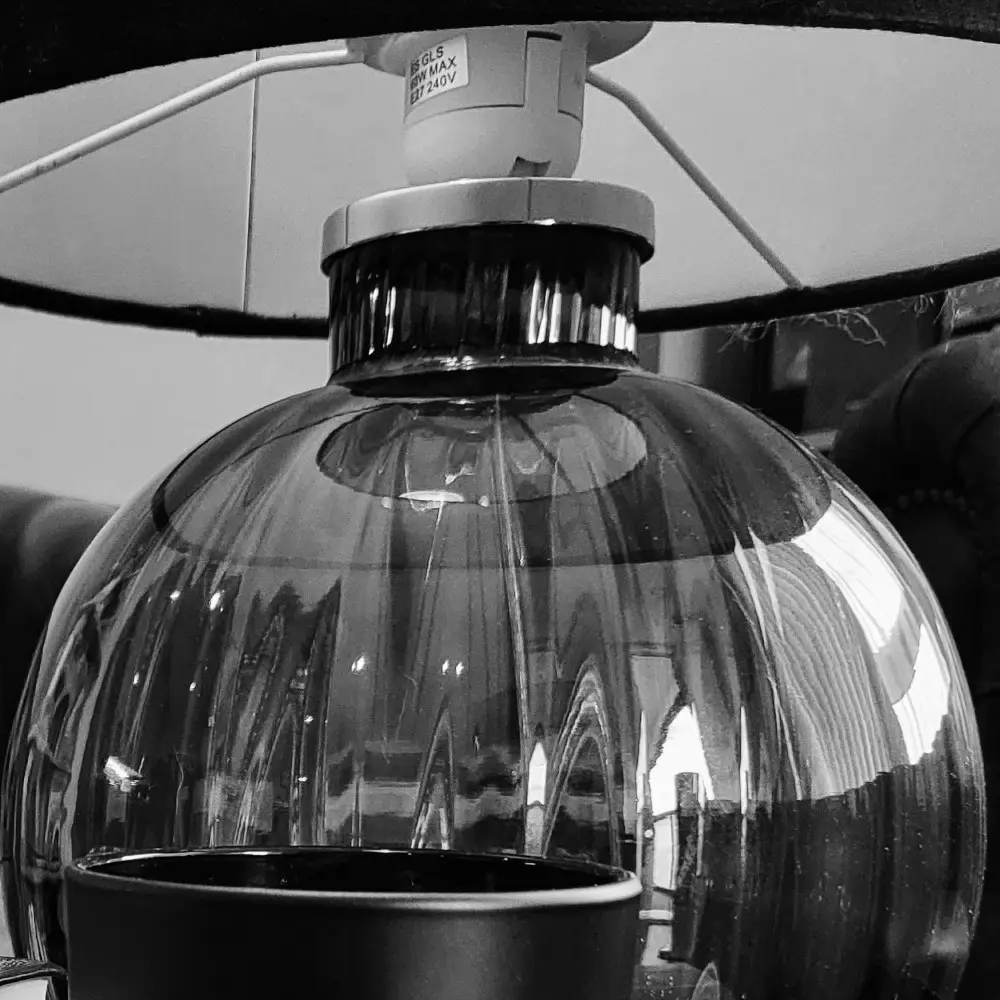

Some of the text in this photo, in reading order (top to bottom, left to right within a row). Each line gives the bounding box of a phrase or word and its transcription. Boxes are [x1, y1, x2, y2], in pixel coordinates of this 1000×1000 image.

[421, 46, 444, 66] GLS
[429, 55, 457, 77] MAX
[427, 71, 457, 93] 240V
